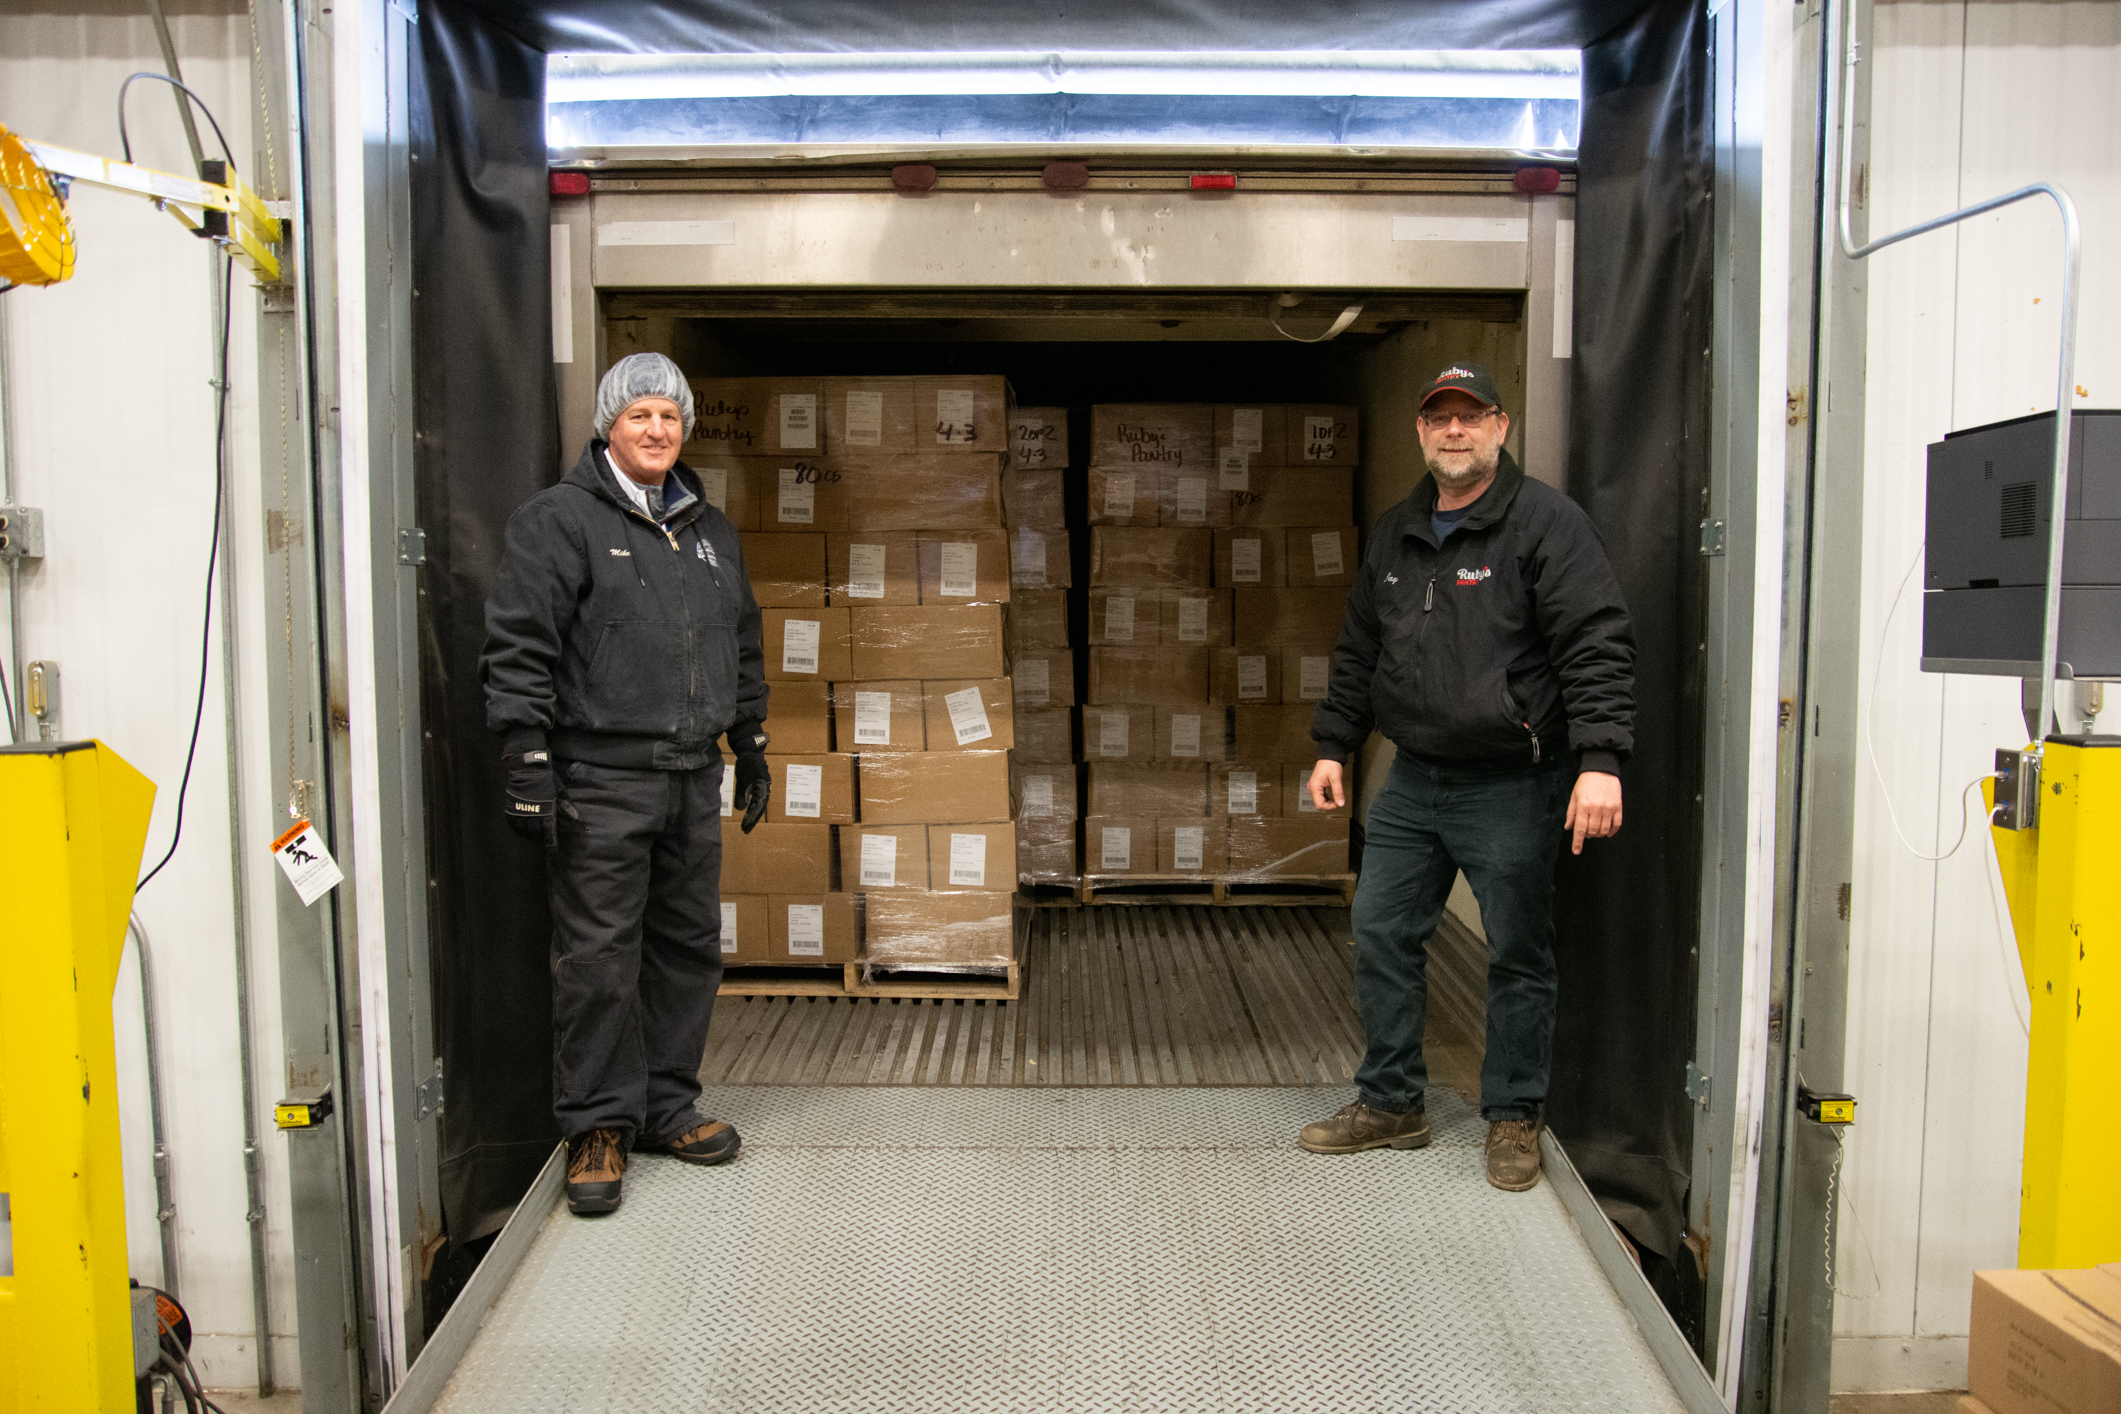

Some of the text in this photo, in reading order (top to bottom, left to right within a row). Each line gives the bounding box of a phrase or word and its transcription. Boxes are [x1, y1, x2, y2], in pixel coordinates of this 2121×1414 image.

[1132, 443, 1182, 468] Pantry
[1457, 566, 1491, 581] Ruby's
[515, 802, 541, 813] ULINE
[280, 823, 305, 844] WARNING
